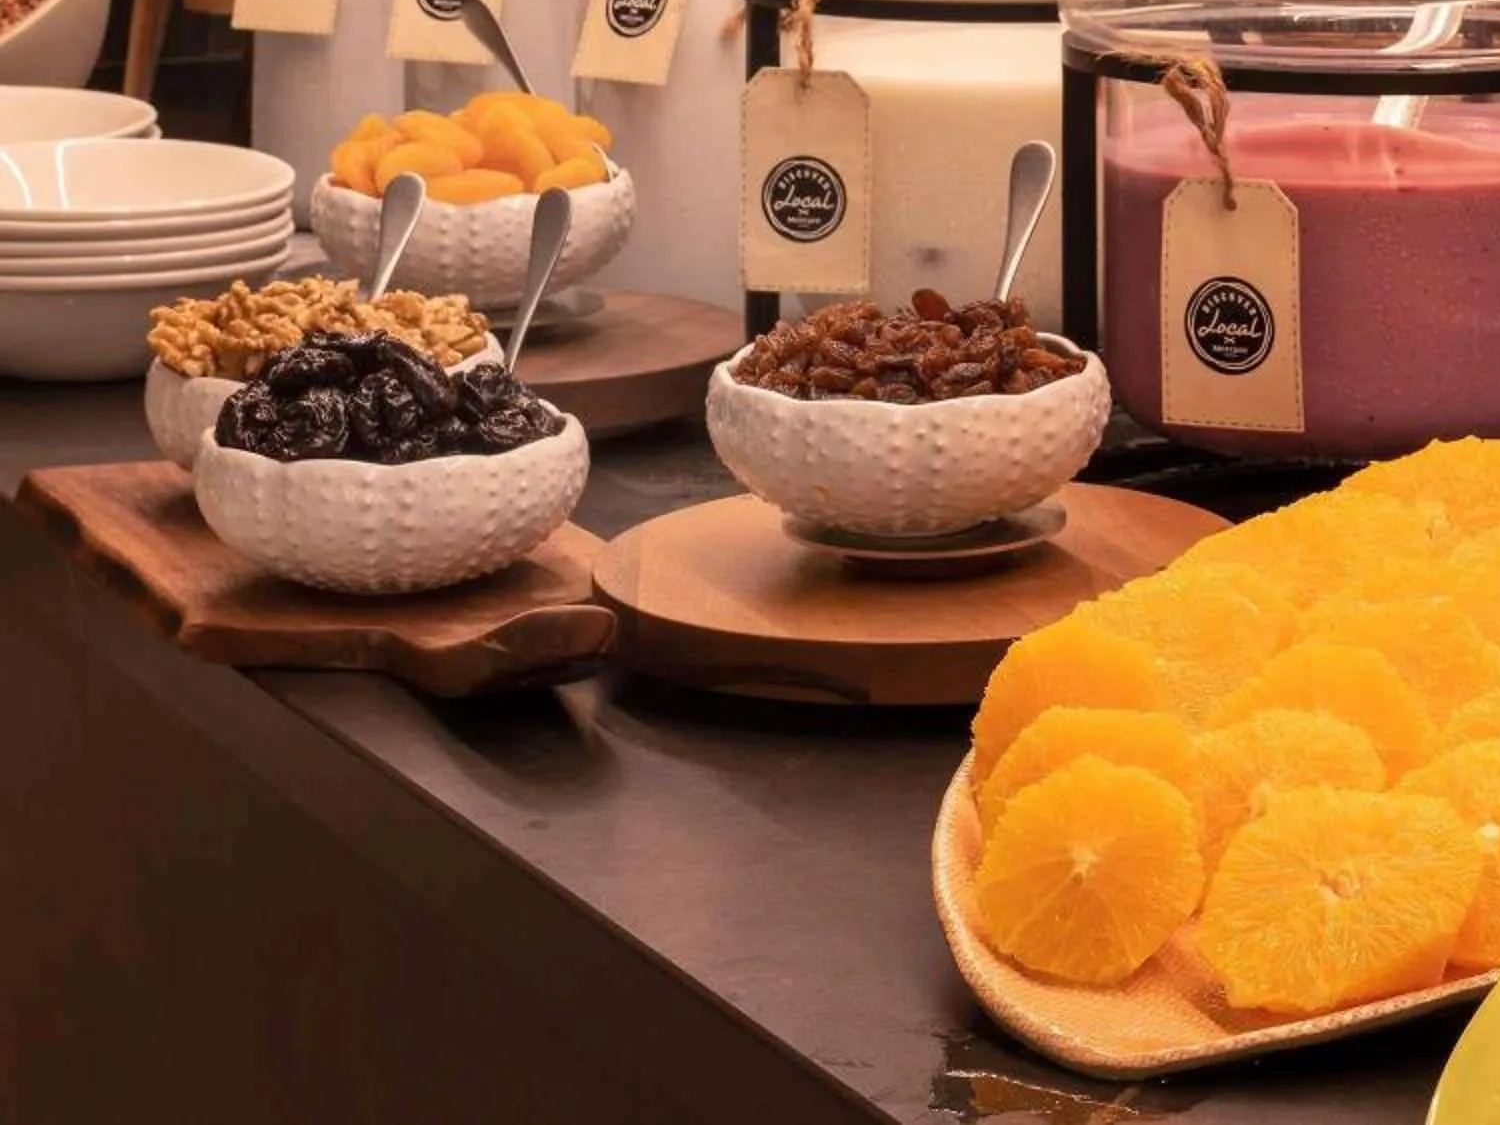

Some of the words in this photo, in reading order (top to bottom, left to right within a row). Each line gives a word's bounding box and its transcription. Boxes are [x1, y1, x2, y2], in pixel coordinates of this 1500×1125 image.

[774, 183, 835, 212] Local
[1201, 291, 1257, 316] DISCOVER
[1197, 307, 1262, 338] Local
